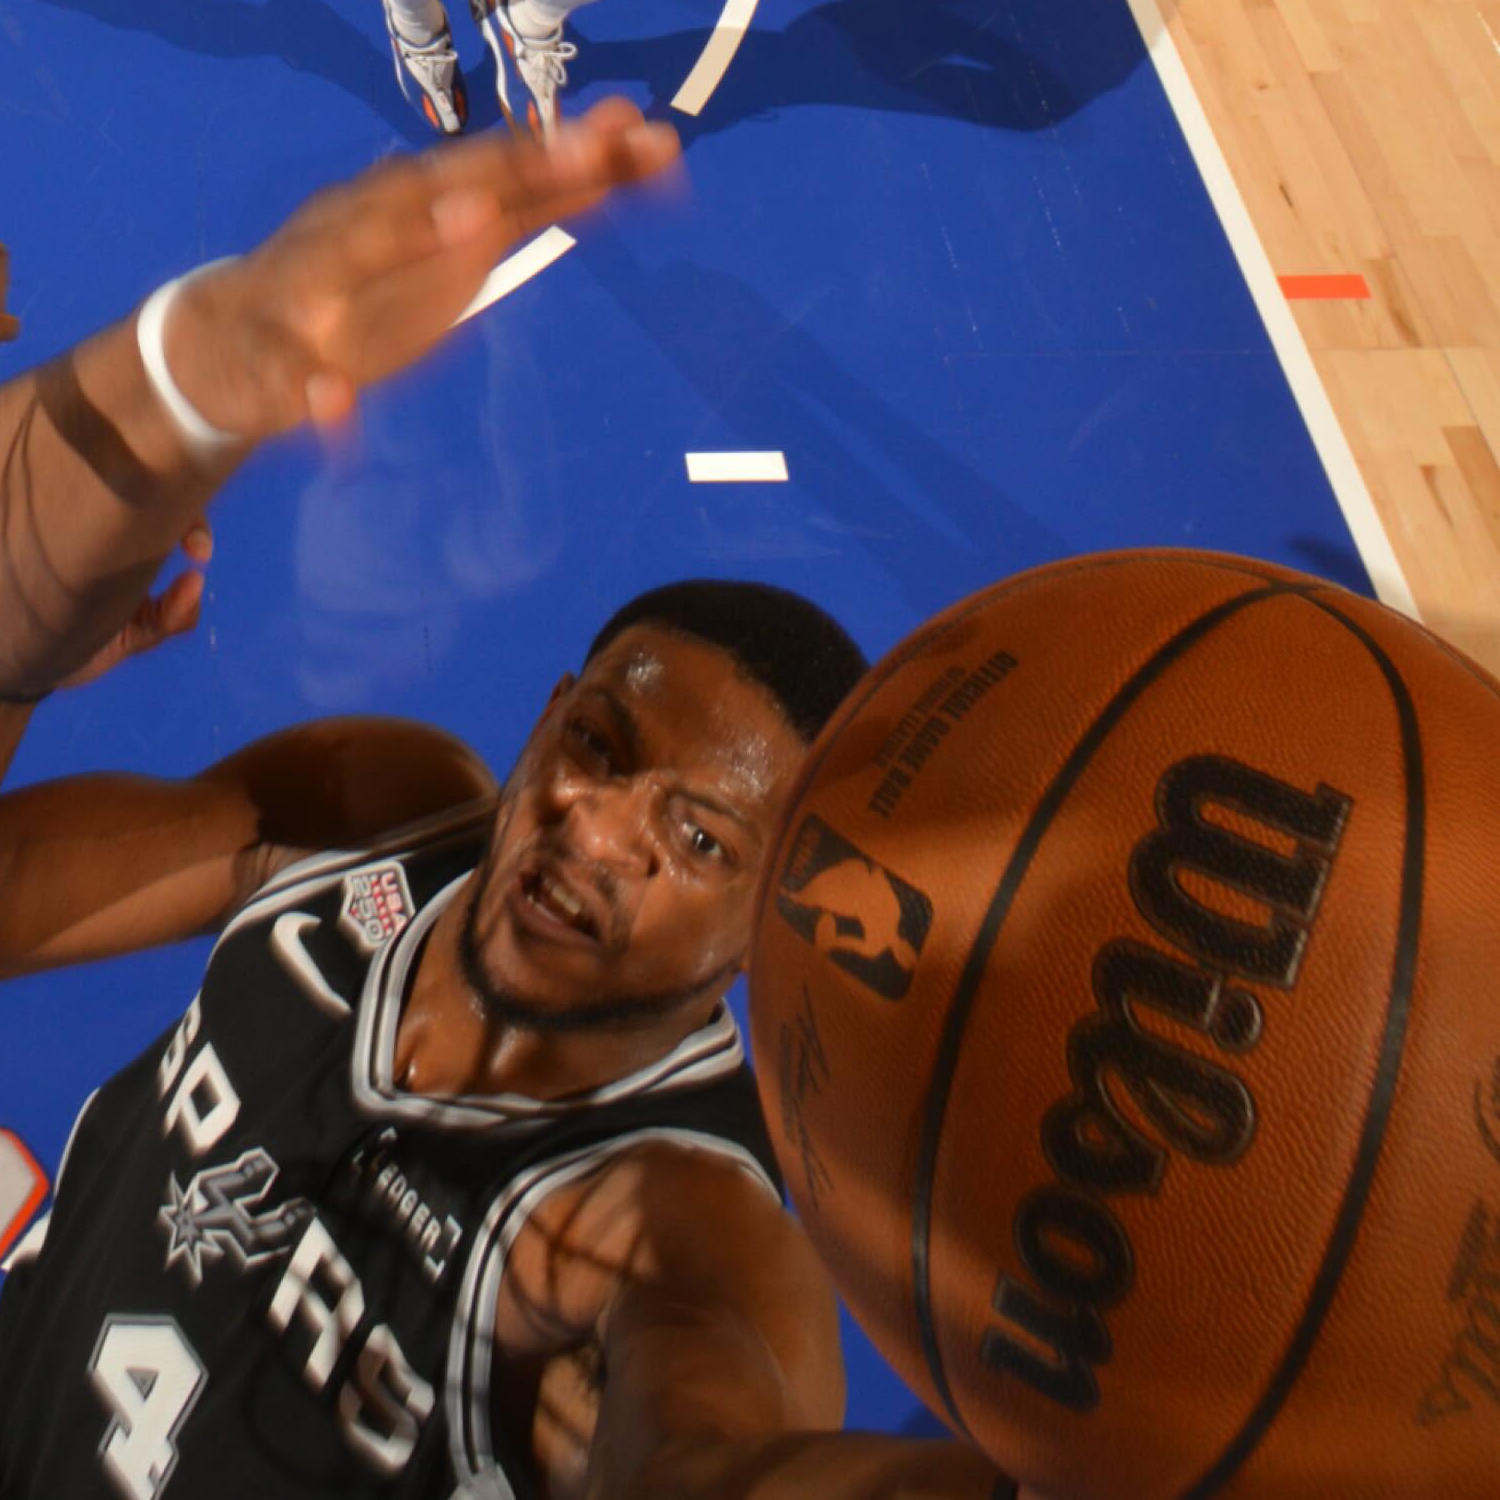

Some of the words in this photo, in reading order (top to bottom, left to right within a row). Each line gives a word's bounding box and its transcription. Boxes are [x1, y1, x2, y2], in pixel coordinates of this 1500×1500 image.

[981, 753, 1355, 1415] Wilson
[371, 1148, 443, 1253] EDGER
[87, 1313, 209, 1500] 4
